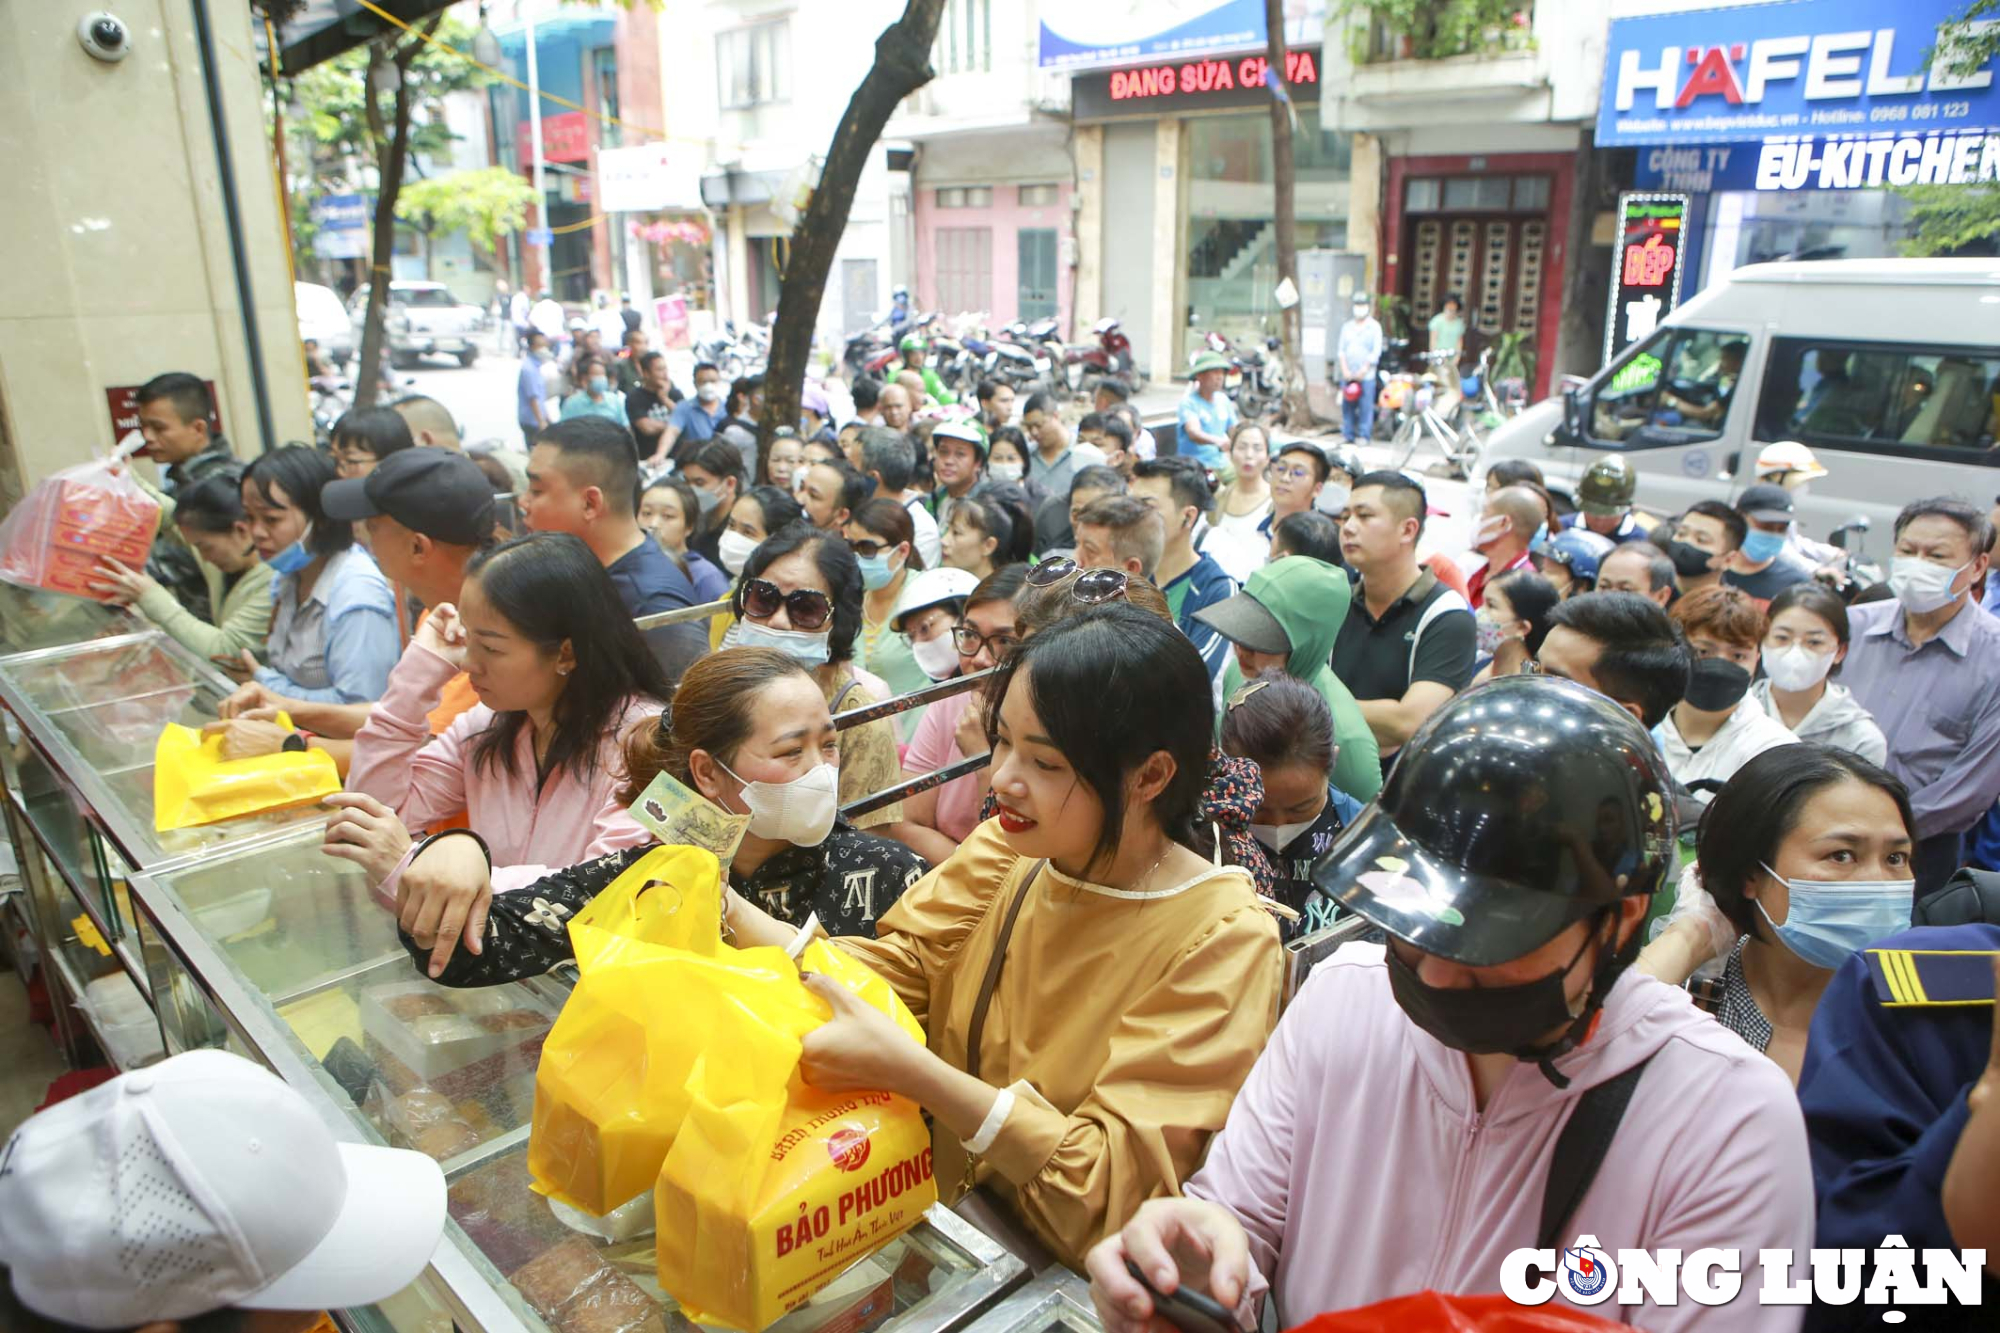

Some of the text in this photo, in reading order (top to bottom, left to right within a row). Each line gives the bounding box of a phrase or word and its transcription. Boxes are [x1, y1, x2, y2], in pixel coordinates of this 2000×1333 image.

[1110, 70, 1176, 100] ĐANG
[1180, 59, 1234, 93] SỬA
[1615, 19, 2000, 112] HÄFELE
[1943, 101, 1969, 118] 123
[776, 1147, 934, 1258] BẢO PHƯƠNG
